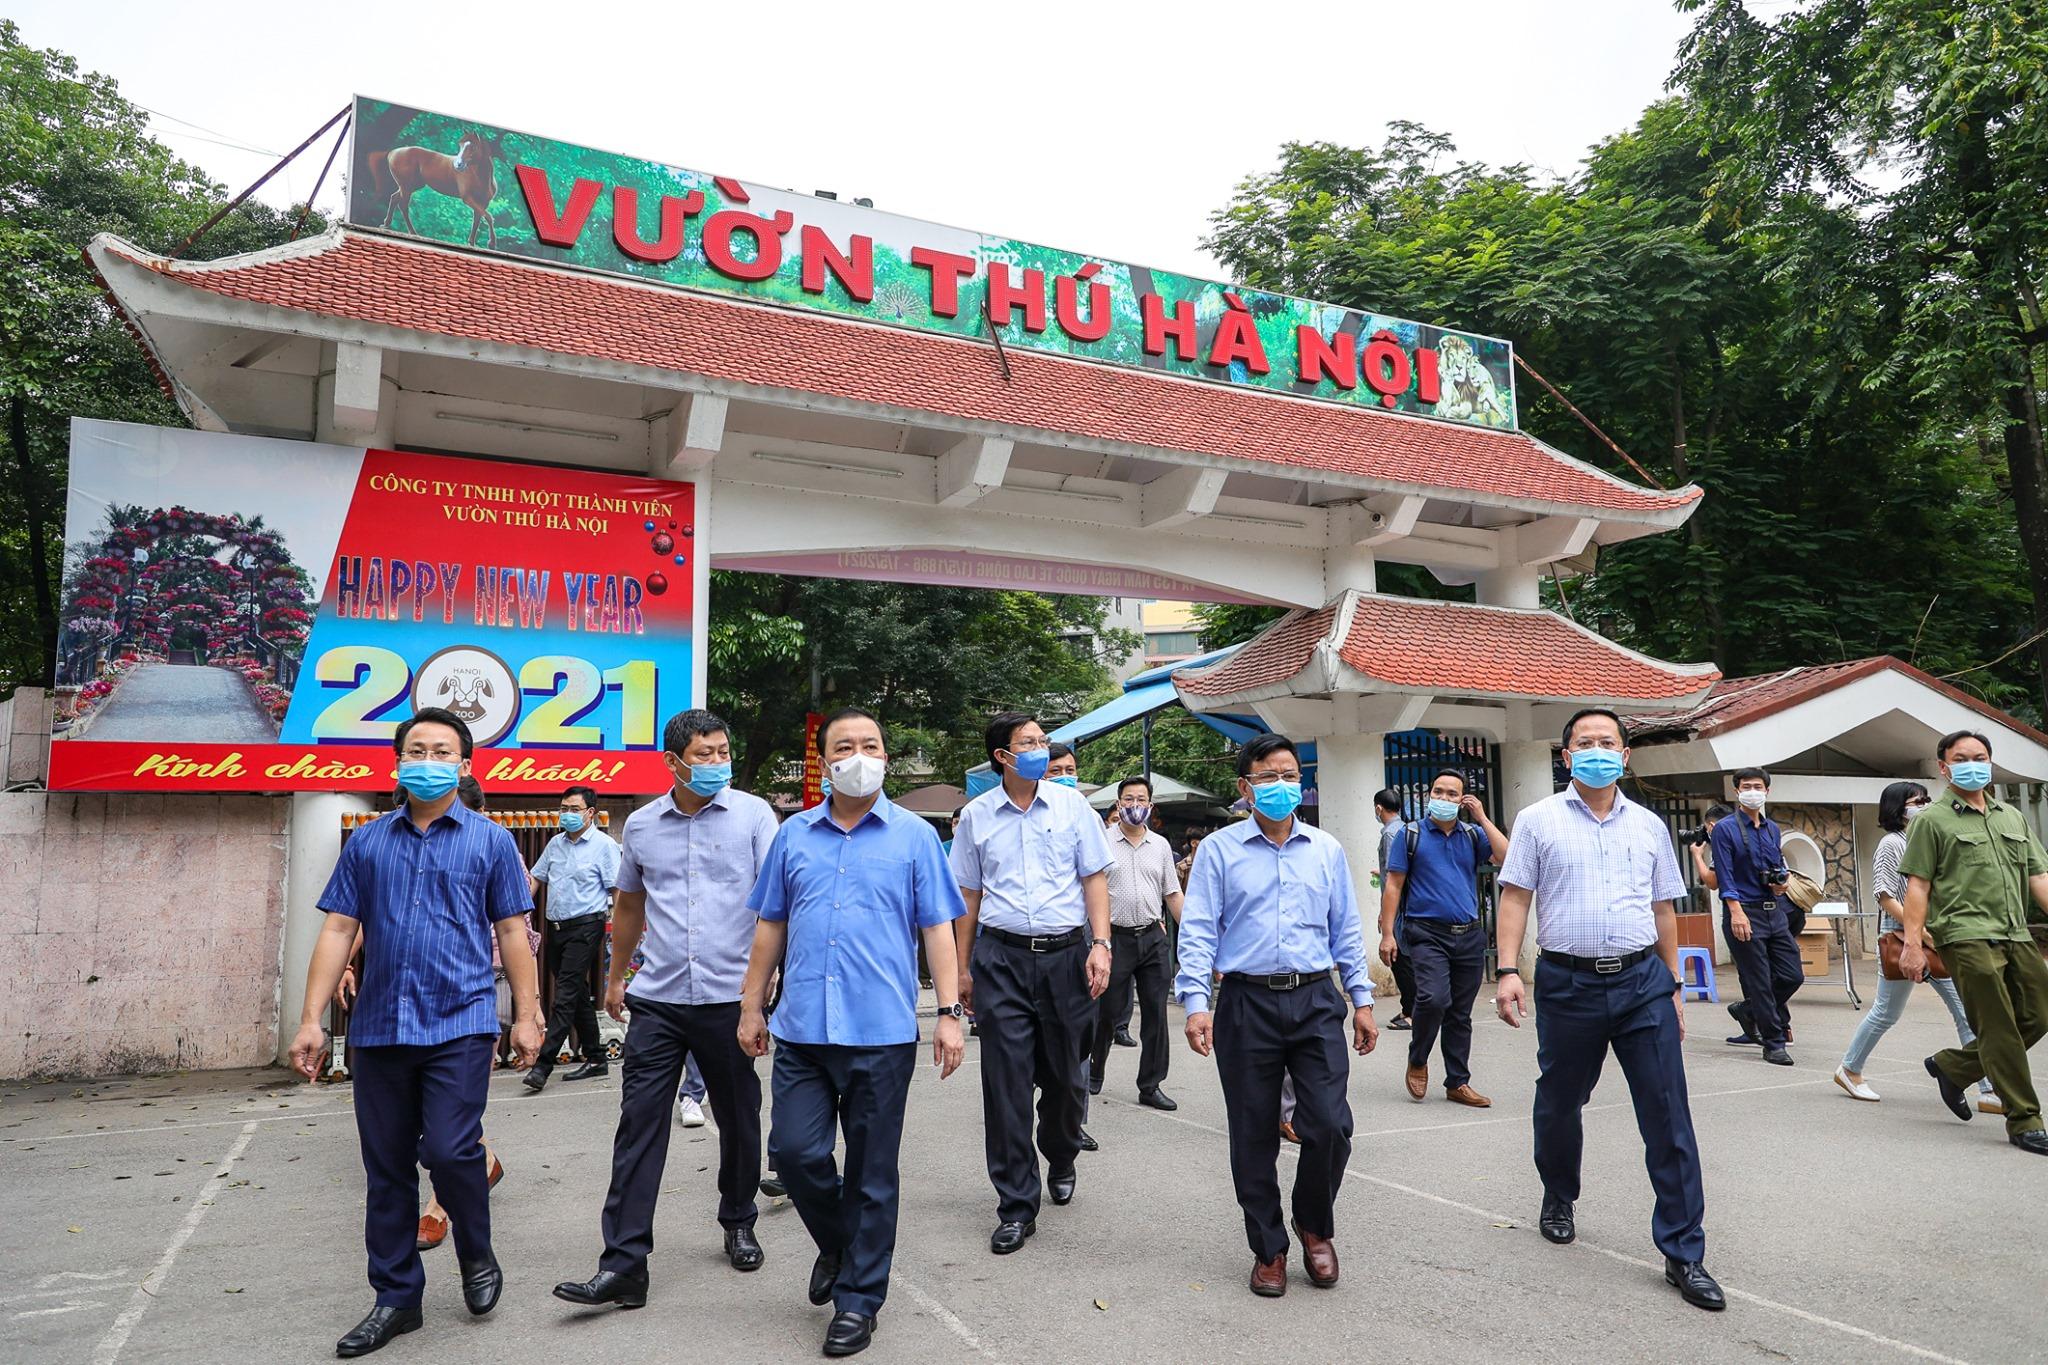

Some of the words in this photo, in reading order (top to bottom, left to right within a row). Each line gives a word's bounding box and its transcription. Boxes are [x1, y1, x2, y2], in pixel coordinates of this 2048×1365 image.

[515, 164, 874, 303] VƯỜN
[911, 246, 1112, 343] THÚ
[1141, 292, 1271, 375] HÀ
[1295, 324, 1440, 409] NỘI
[369, 473, 427, 494] CÔNG
[431, 481, 460, 498] TY
[461, 484, 515, 503] TNHH
[519, 489, 564, 509] MỘT
[565, 490, 628, 514] THÀNH
[631, 497, 673, 518] VIÊN
[442, 505, 499, 524] VƯỜN
[502, 509, 542, 527] THÚ
[546, 513, 573, 531] HÀ
[576, 515, 609, 536] NỘI
[337, 555, 461, 624] HAPPY
[474, 566, 550, 629] NEW
[563, 571, 645, 635] YEAR
[453, 667, 481, 675] HANOI
[455, 710, 476, 719] ZOO
[133, 752, 247, 780] Kính
[264, 754, 376, 780] chào
[485, 757, 626, 784] khách!
